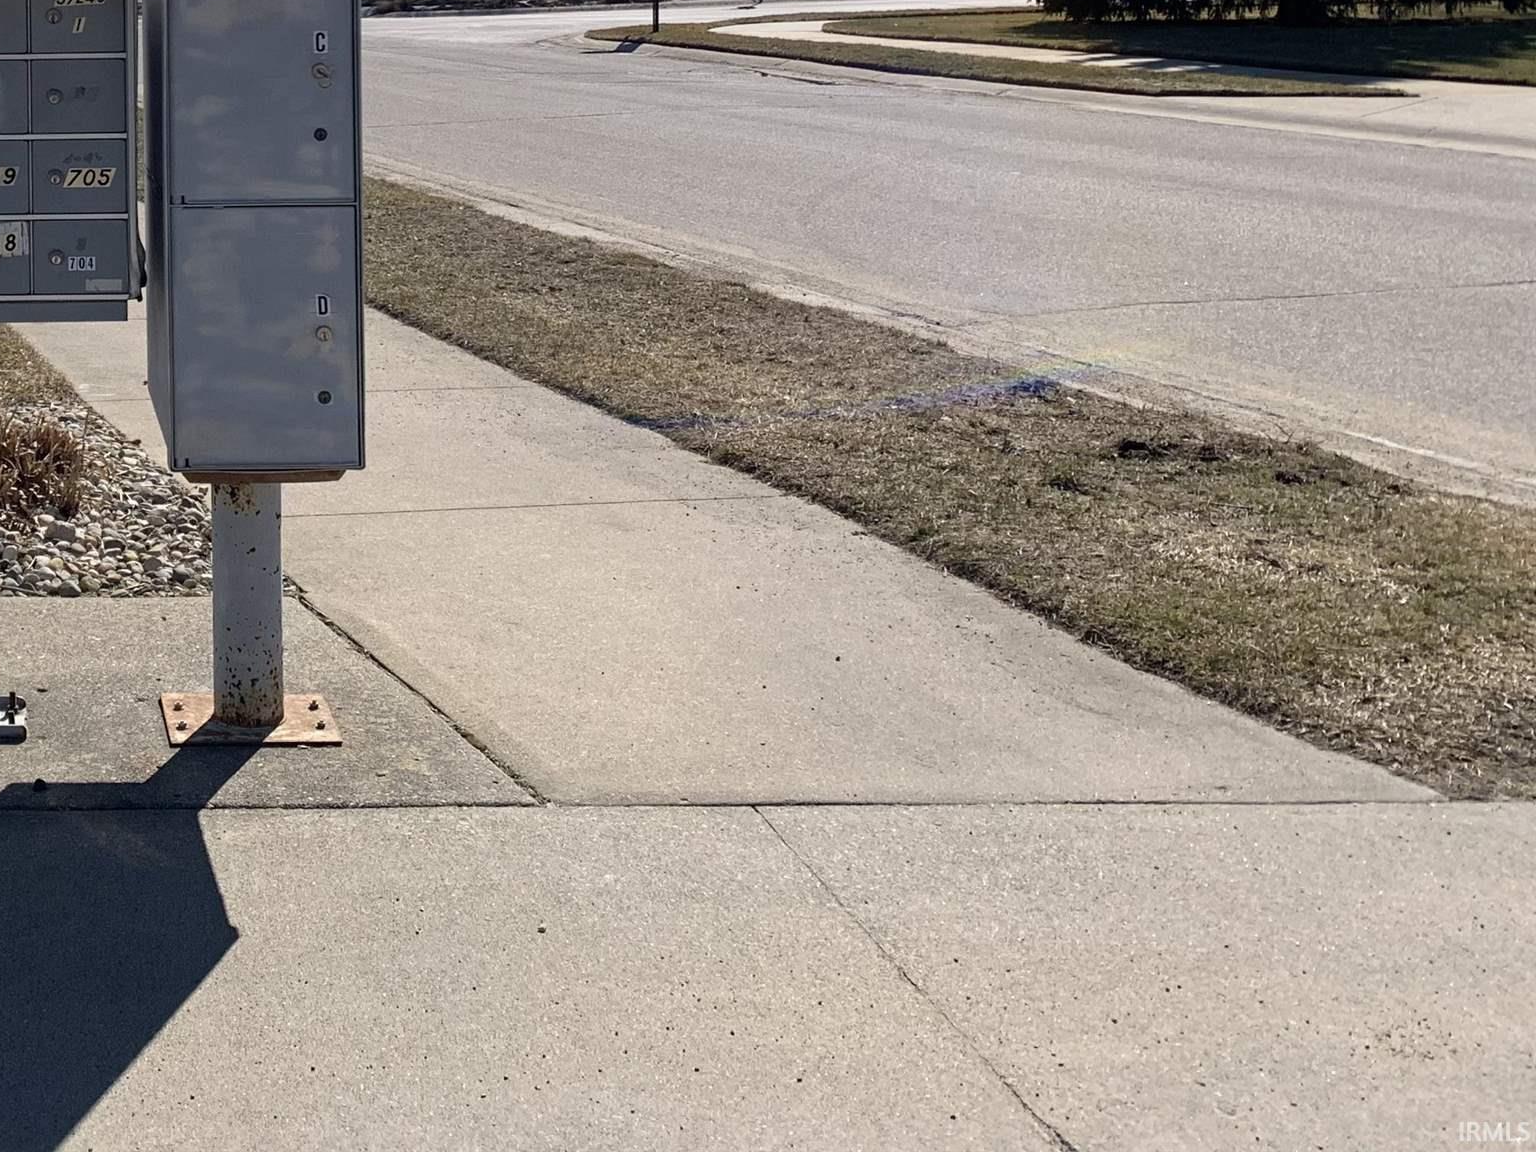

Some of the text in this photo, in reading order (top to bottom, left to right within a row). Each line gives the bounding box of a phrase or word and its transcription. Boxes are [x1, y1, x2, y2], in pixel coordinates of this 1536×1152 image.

[315, 32, 326, 52] C
[67, 168, 112, 186] 705
[70, 257, 94, 270] 704
[317, 295, 328, 315] D
